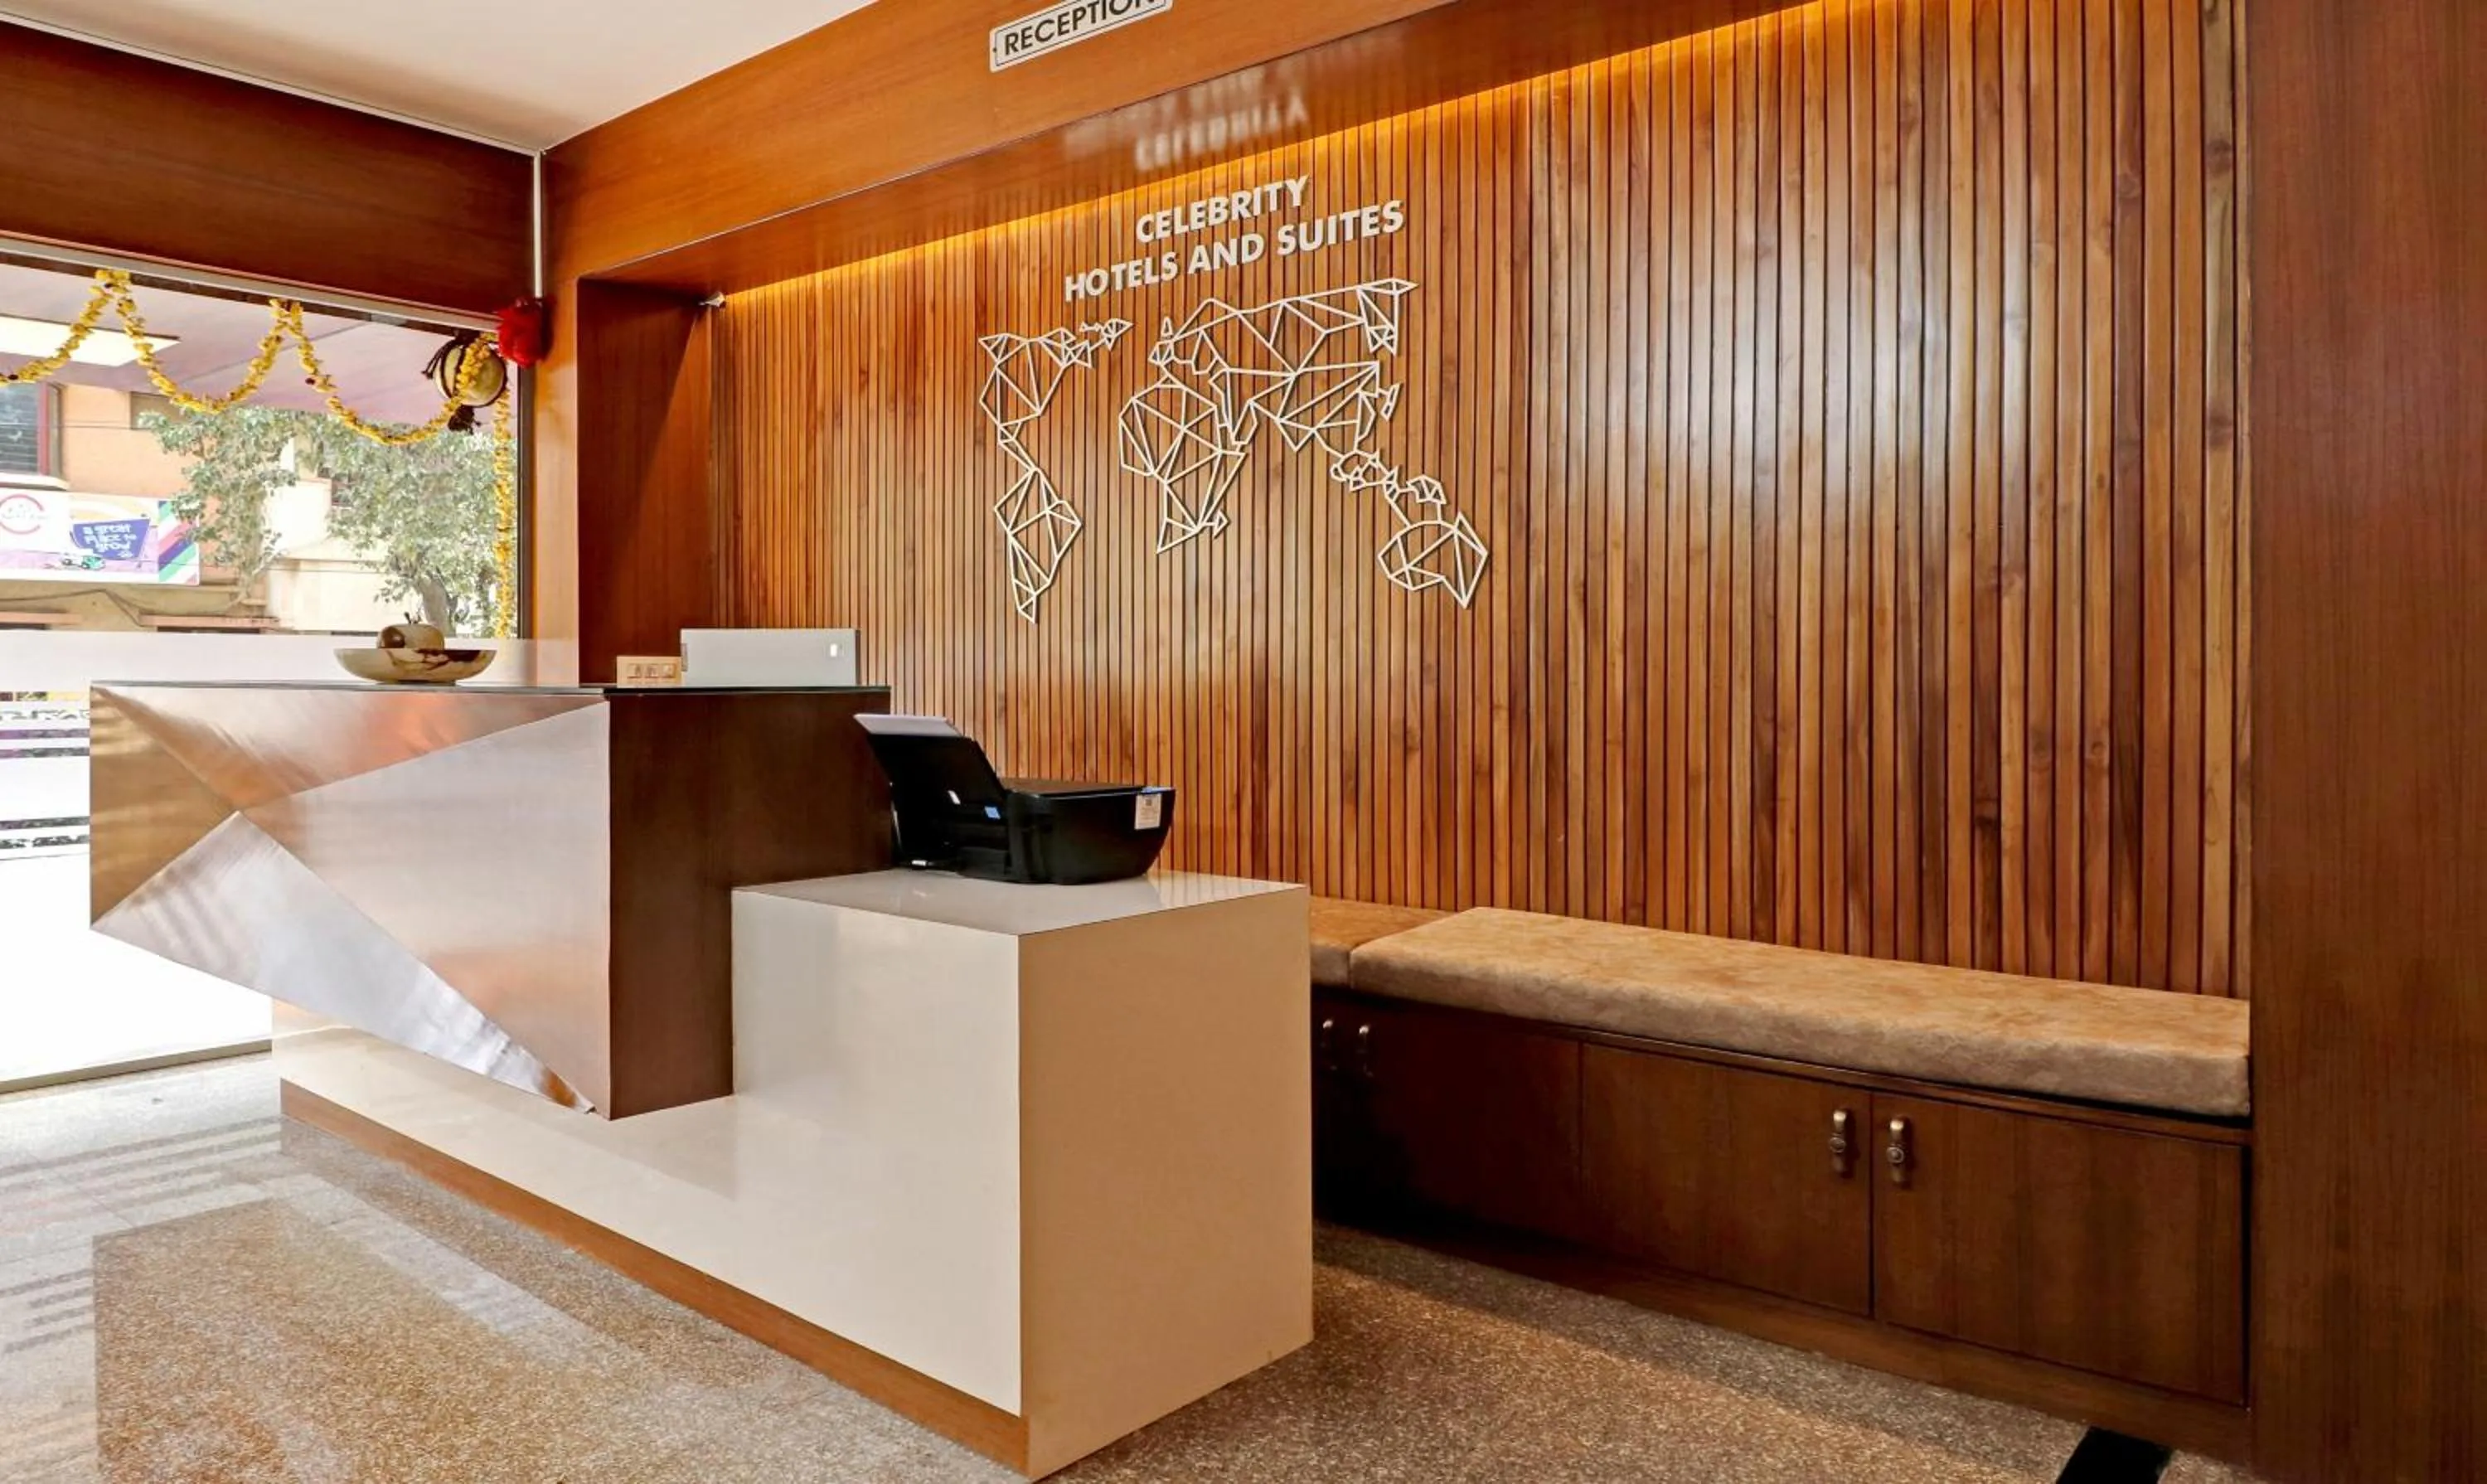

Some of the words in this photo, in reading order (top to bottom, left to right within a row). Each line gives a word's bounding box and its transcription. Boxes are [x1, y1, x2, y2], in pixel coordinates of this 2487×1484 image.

[1004, 0, 1155, 56] RECEPTIO
[1136, 173, 1310, 243] CELEBRITY
[1064, 250, 1179, 303] HOTELS
[1187, 232, 1265, 275] AND
[1277, 199, 1404, 257] SUITES
